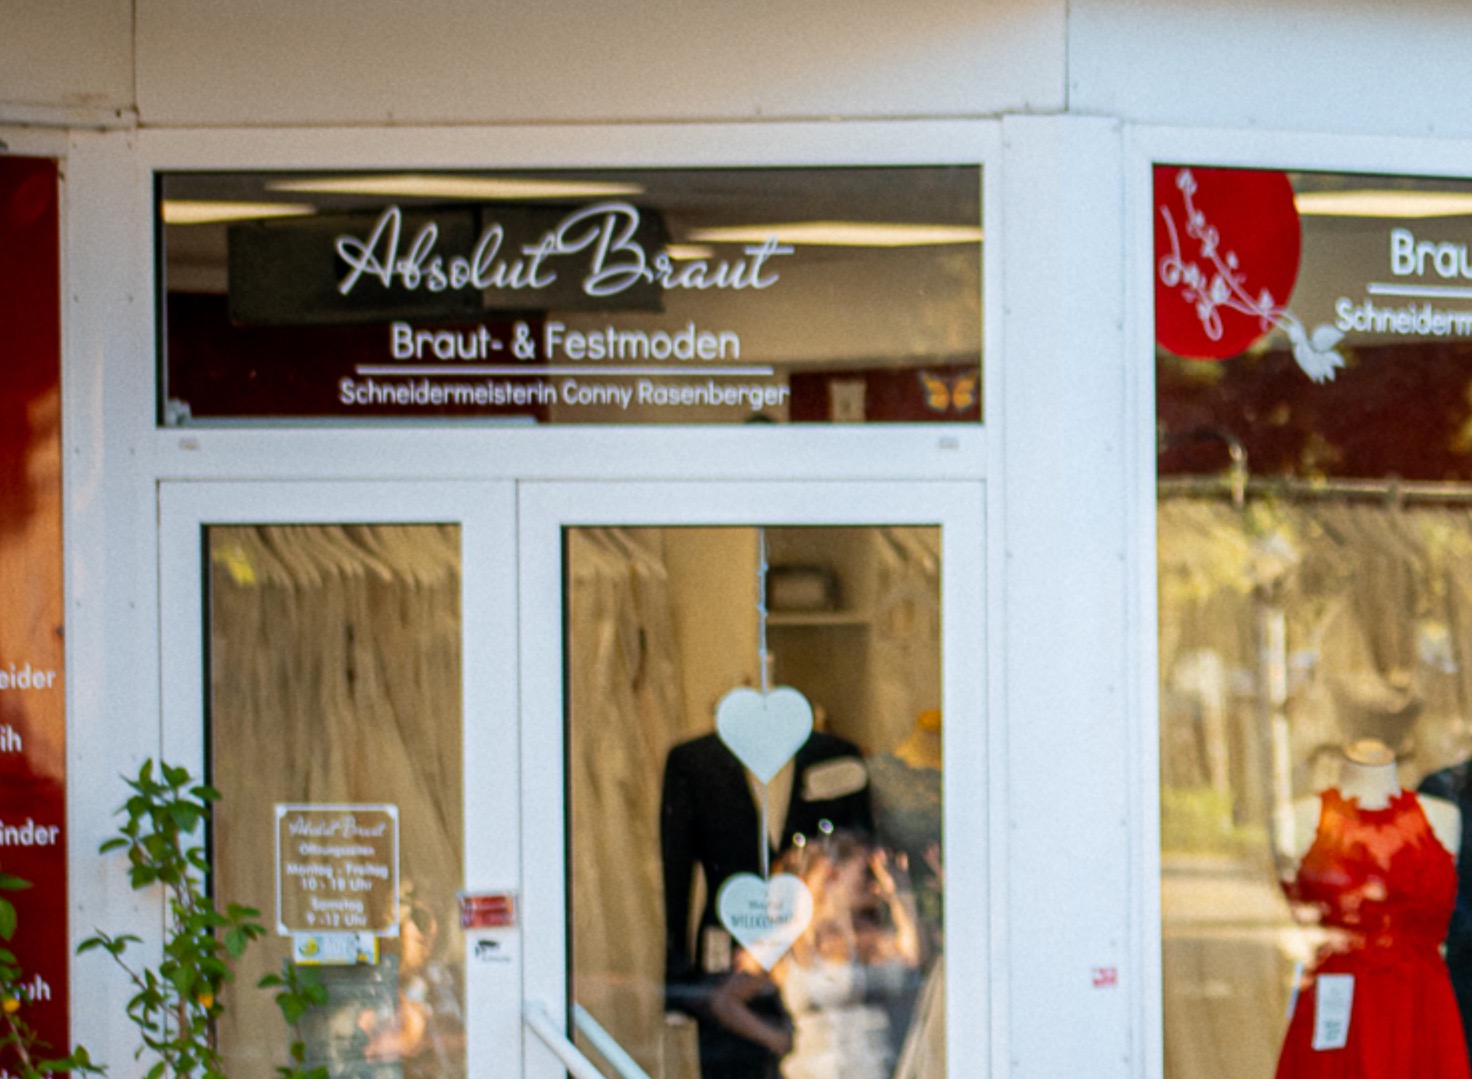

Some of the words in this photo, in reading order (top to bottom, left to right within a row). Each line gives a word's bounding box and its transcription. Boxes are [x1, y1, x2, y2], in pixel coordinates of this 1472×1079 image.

[335, 204, 565, 296] Absolut
[556, 202, 795, 297] Braut
[391, 322, 503, 360] Braut-
[511, 322, 536, 360] &
[545, 322, 741, 361] Festmoden
[340, 379, 557, 405] Schneidermeisterin
[563, 379, 632, 409] Conny
